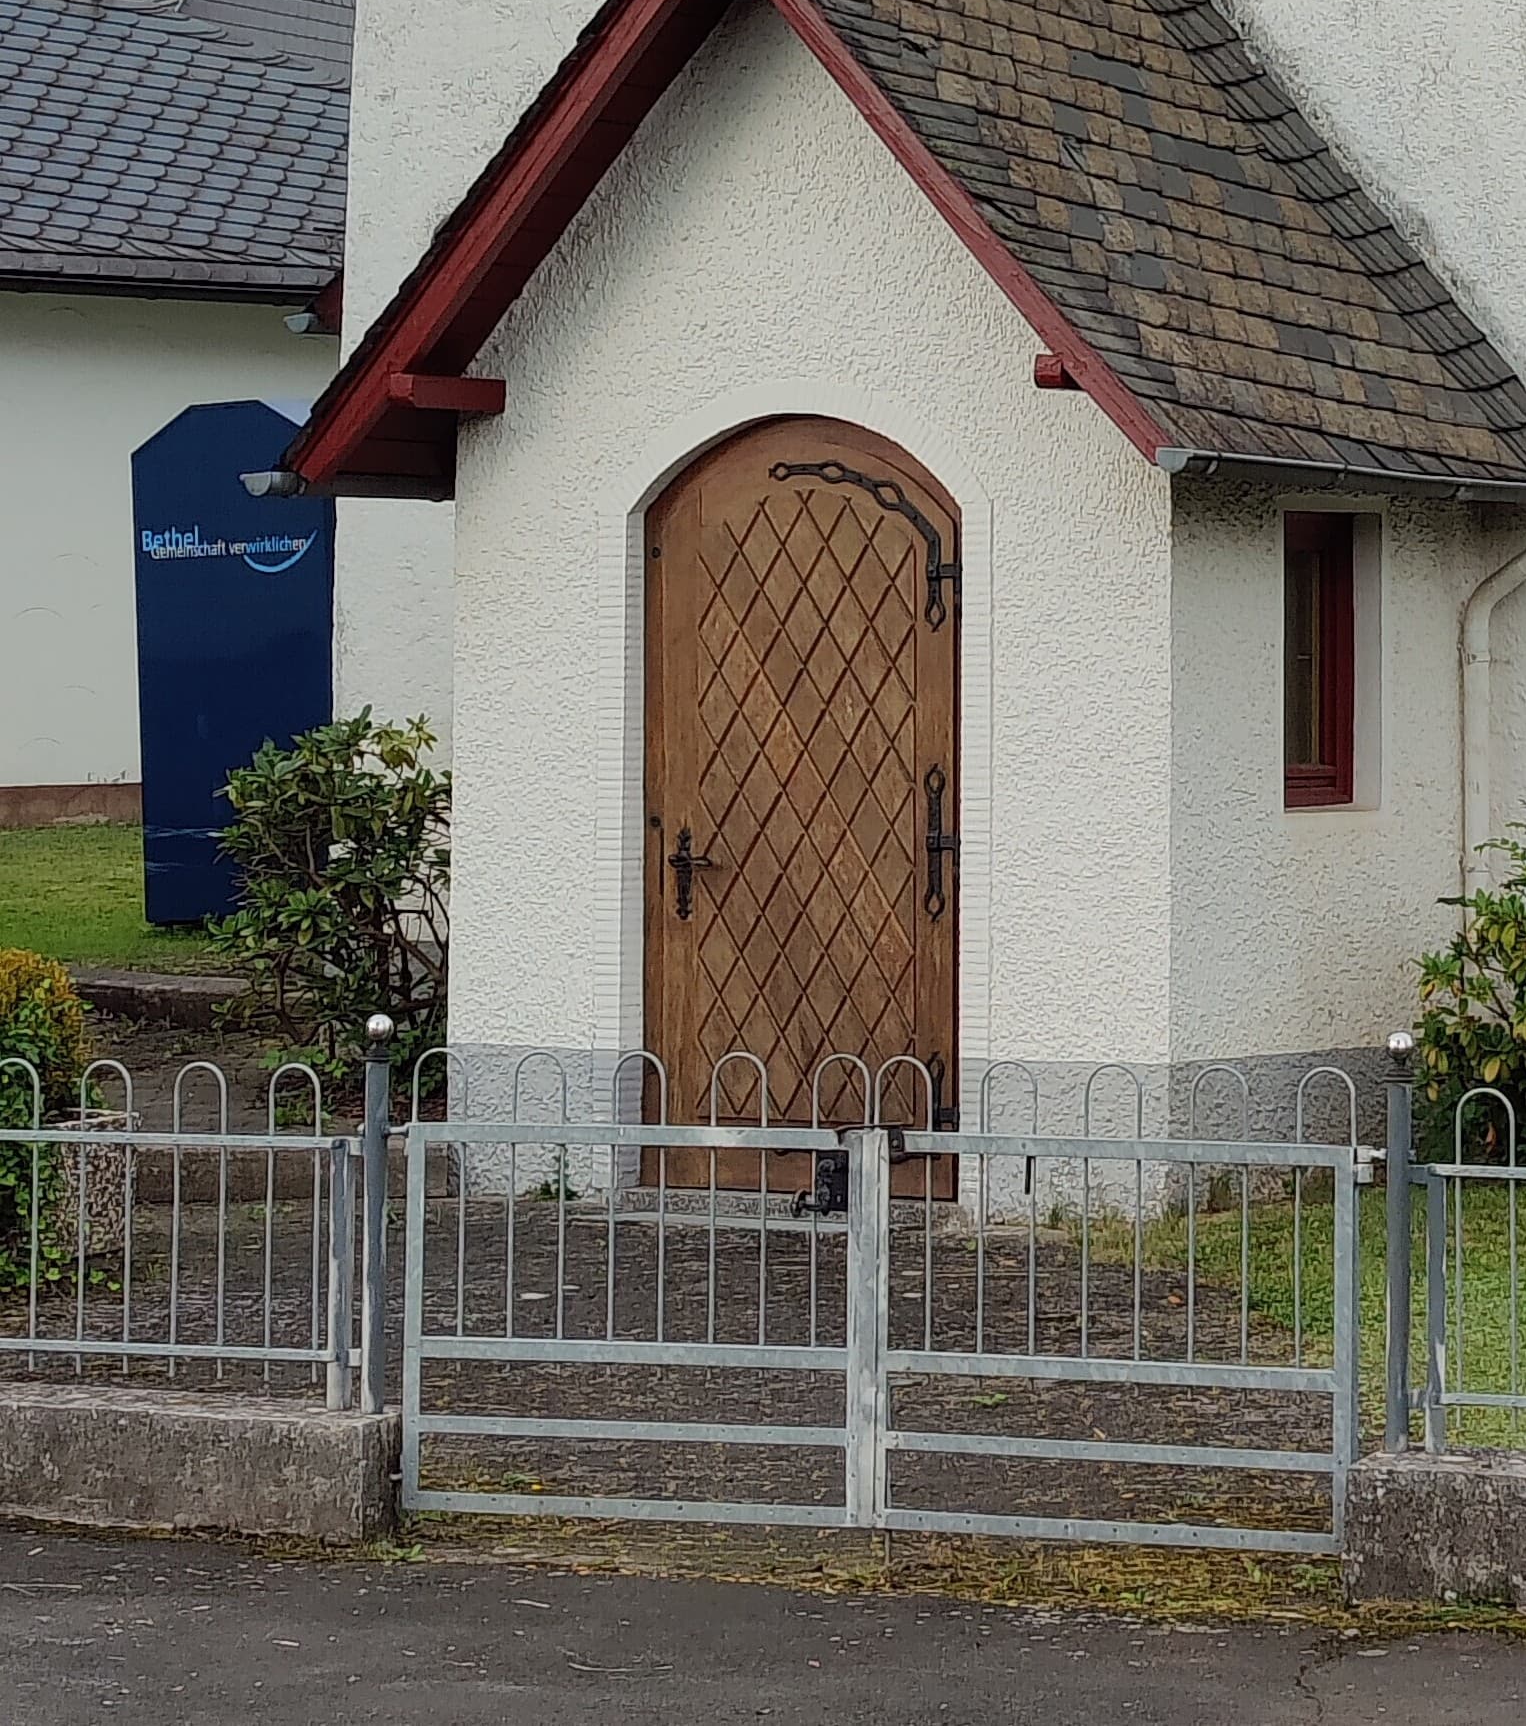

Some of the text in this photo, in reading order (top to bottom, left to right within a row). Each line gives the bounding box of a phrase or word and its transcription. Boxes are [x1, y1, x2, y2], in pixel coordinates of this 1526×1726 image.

[141, 525, 199, 551] Bethel
[151, 535, 307, 559] Gemeinschaft verwirklichen
